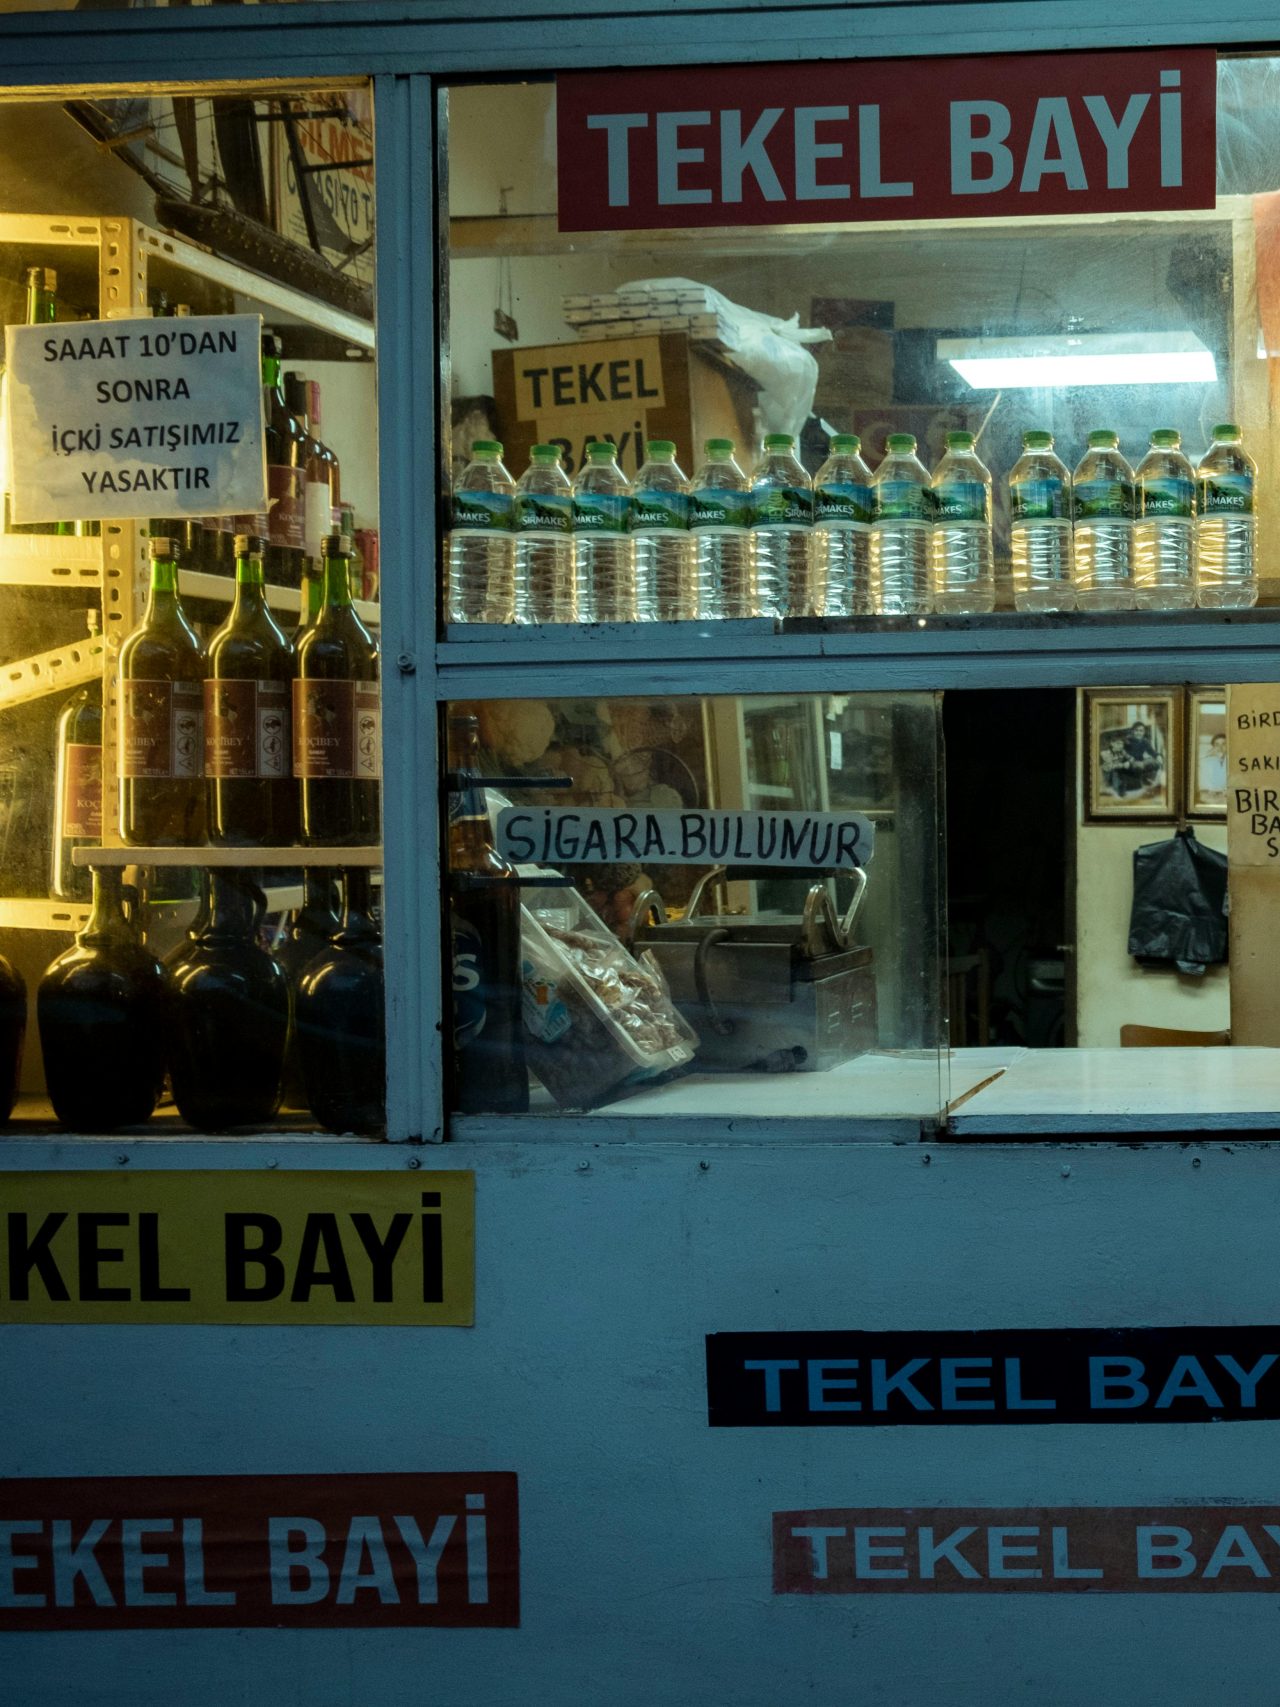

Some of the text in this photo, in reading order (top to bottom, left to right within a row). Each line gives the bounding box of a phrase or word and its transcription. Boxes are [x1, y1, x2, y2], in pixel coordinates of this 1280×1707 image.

[587, 69, 1183, 207] TEKEL BAYİ
[43, 335, 131, 363] SAAAT
[95, 377, 191, 404] SONRA
[522, 358, 659, 408] TEKEL
[108, 421, 241, 452] SATIŞIMIZ
[80, 466, 211, 494] YASAKTIR
[0, 1191, 446, 1304] KEL BAYİ
[744, 1356, 1057, 1413] TEKEL
[268, 1493, 490, 1607] BAYİ
[790, 1524, 1103, 1580] TEKEL
